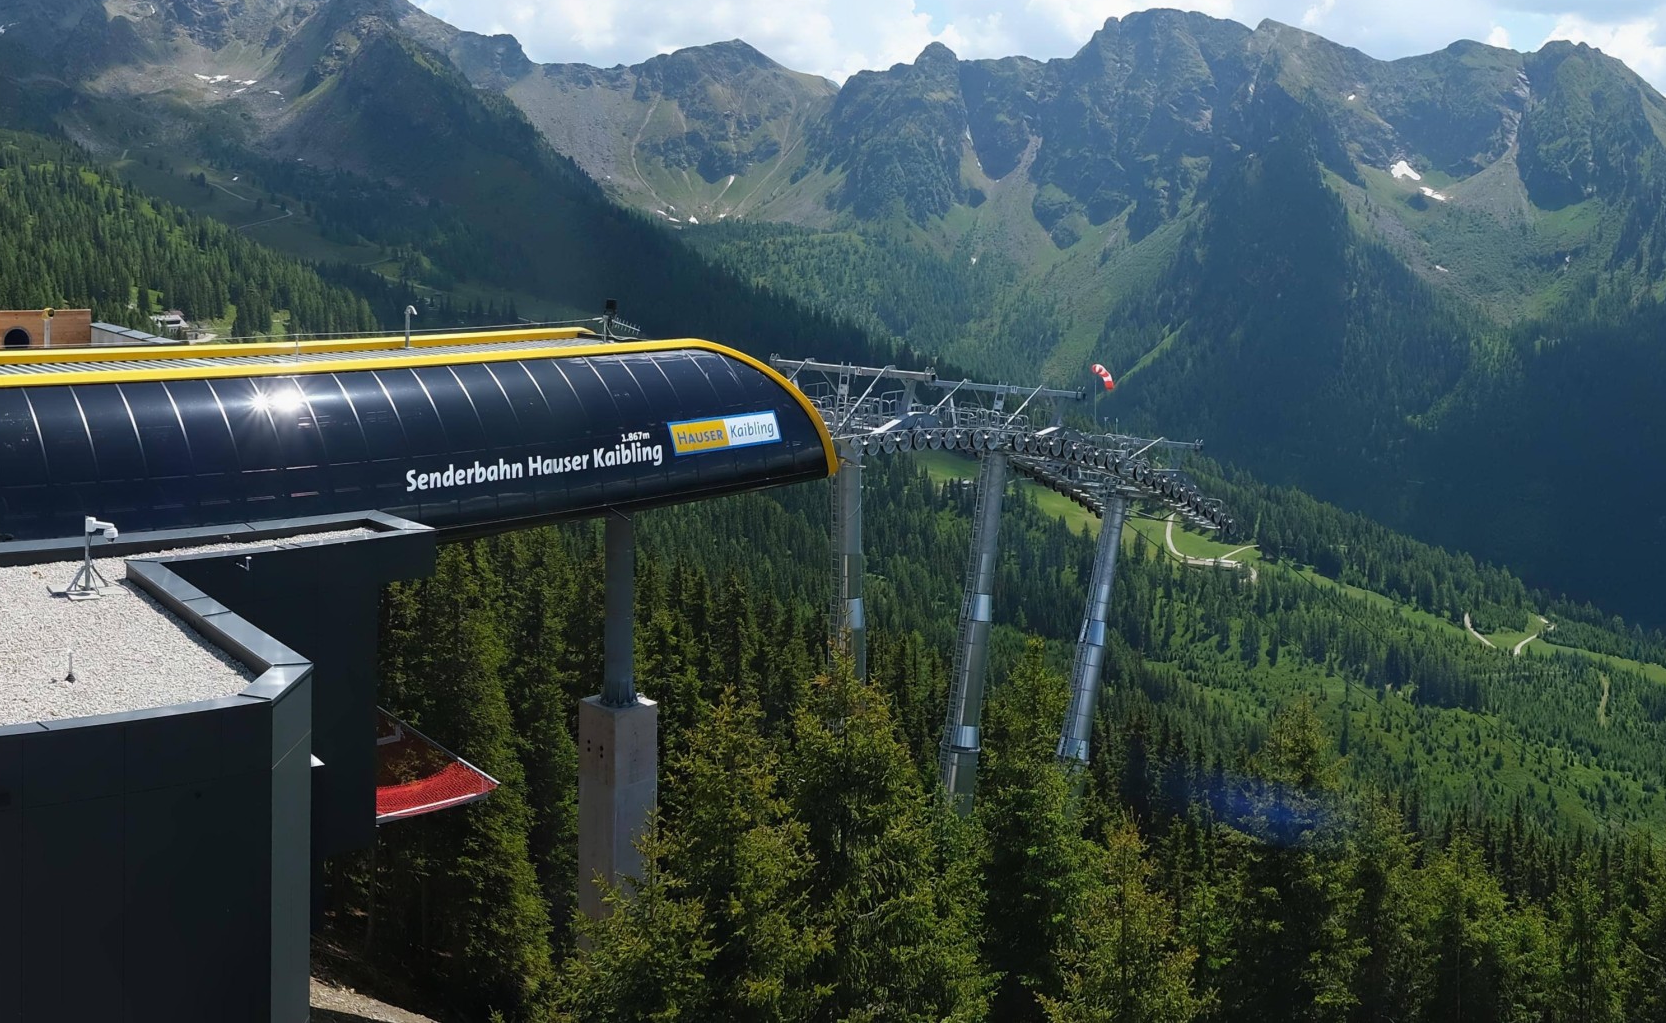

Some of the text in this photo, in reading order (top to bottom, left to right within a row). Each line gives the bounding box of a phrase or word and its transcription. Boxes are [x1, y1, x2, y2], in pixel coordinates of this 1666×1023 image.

[620, 430, 651, 443] 1.867m
[677, 420, 775, 446] HAUSER Kaibling
[406, 442, 664, 492] Senderbahn Hauser Kaibling
